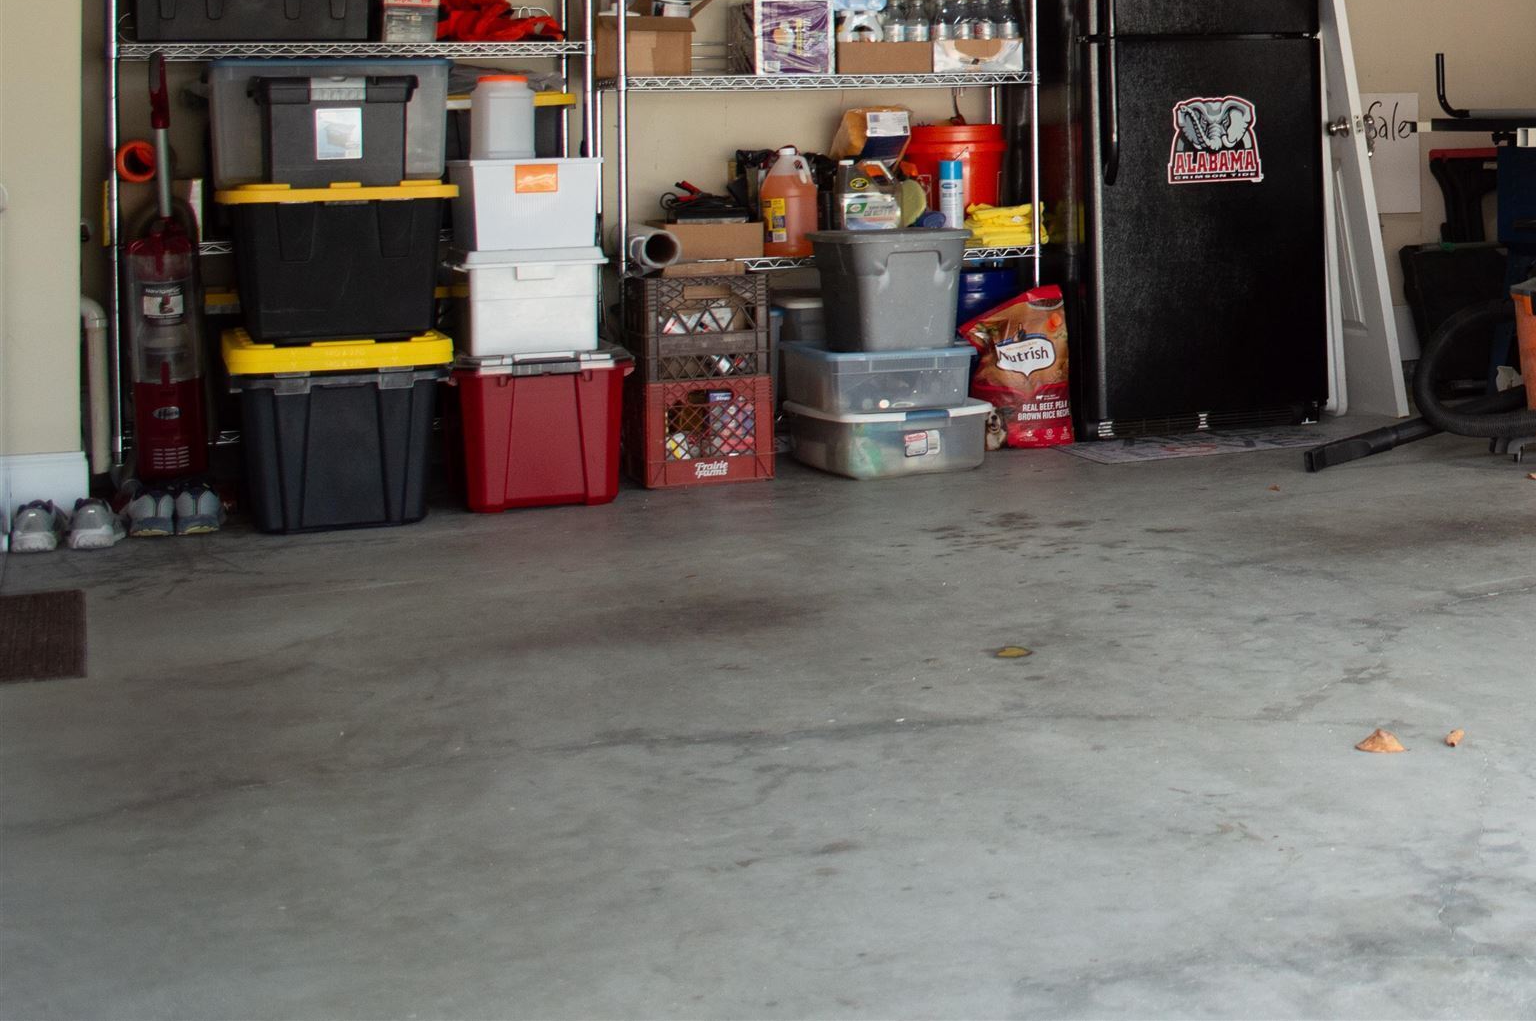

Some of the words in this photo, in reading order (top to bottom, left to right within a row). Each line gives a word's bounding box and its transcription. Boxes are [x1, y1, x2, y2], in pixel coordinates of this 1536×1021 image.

[1174, 149, 1256, 175] ALABAMA
[1000, 347, 1049, 363] Nutrish
[1023, 403, 1038, 412] REAL
[1018, 411, 1041, 420] BROWN
[1042, 410, 1055, 418] RICE
[695, 460, 728, 471] Prairie
[696, 468, 728, 478] Farms
